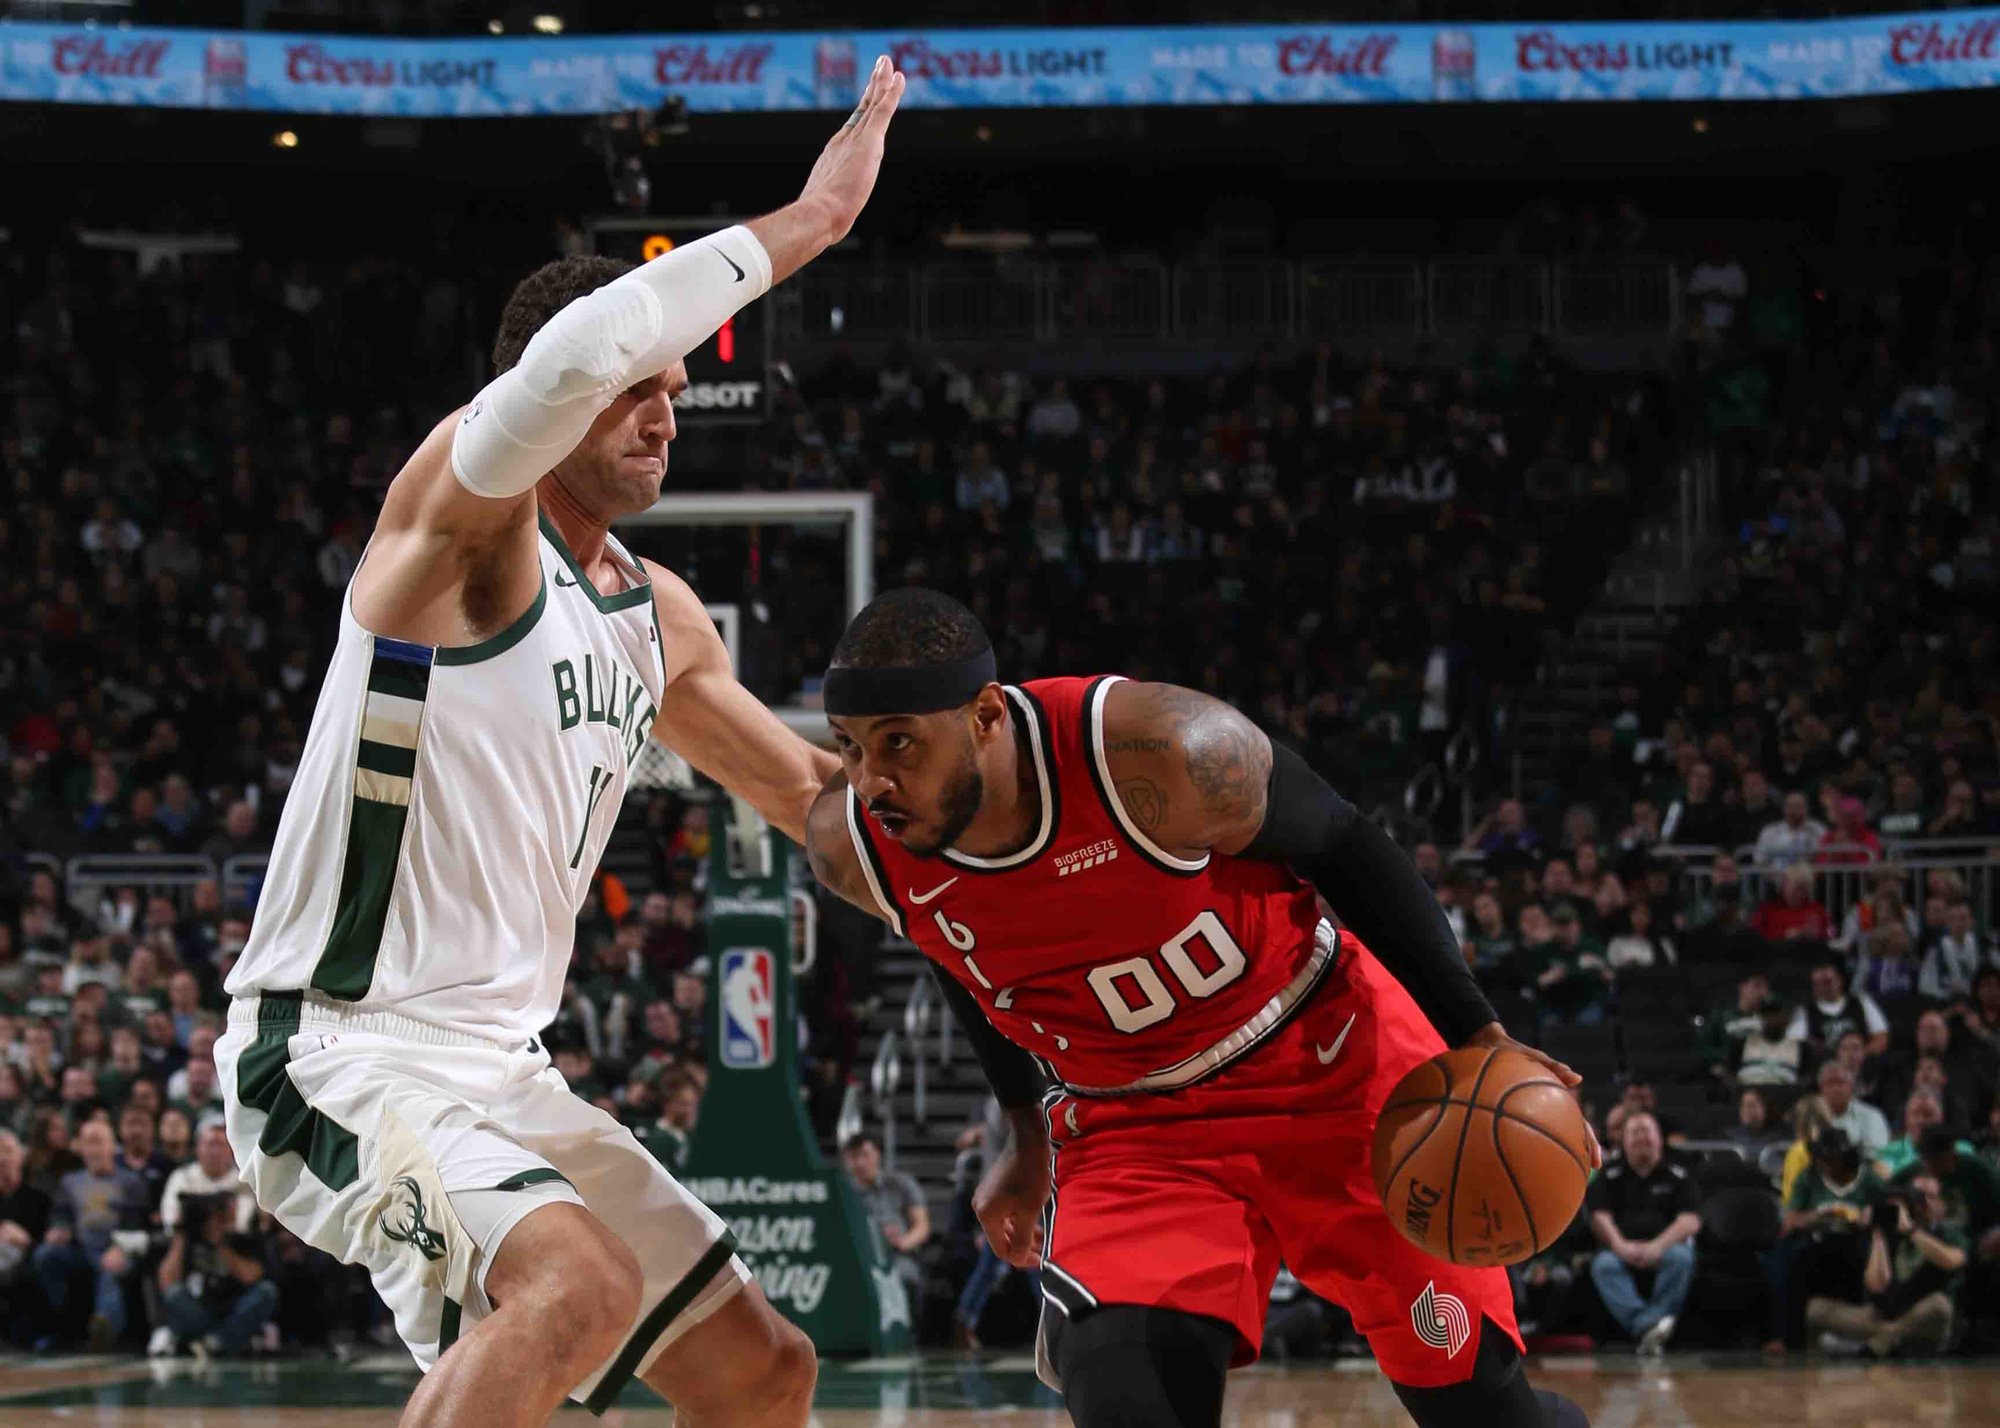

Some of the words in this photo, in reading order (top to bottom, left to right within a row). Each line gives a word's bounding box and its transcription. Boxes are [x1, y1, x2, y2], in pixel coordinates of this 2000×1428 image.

[54, 36, 171, 78] Chill
[889, 38, 1002, 78] Coors
[1008, 46, 1107, 77] LIGHT
[1276, 32, 1397, 76] Chill
[1516, 33, 1629, 72] Coors
[1635, 42, 1734, 71] LIGHT
[1889, 18, 2000, 65] Chill
[285, 42, 395, 86] Coors
[401, 57, 497, 87] LIGHT
[654, 42, 774, 85] Chill
[673, 381, 760, 408] SSOT
[1086, 909, 1248, 1034] 00
[724, 1213, 817, 1253] ason
[744, 1252, 833, 1314] iving
